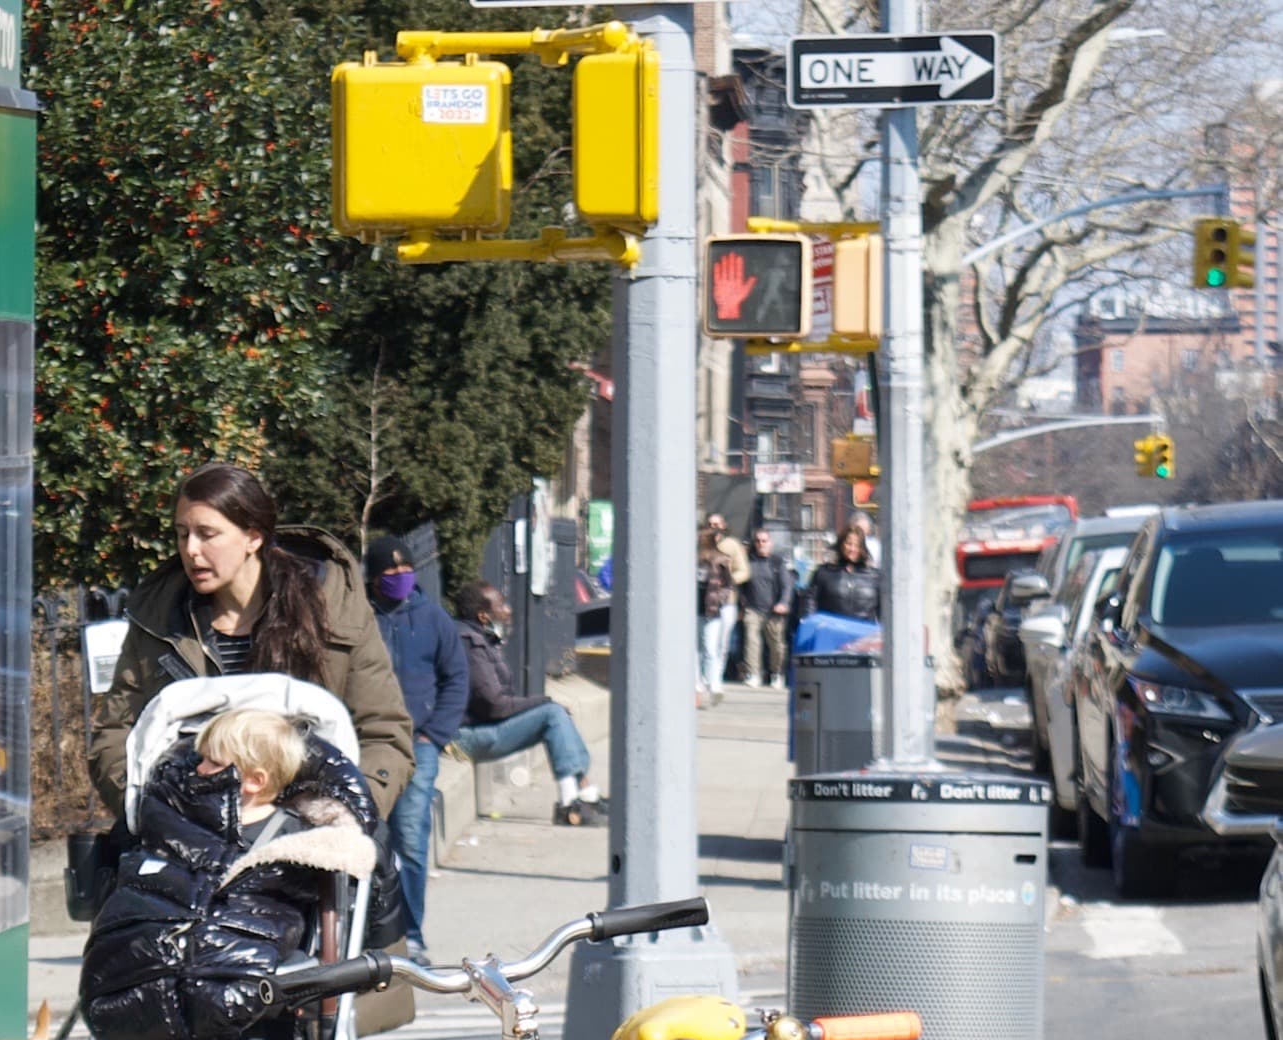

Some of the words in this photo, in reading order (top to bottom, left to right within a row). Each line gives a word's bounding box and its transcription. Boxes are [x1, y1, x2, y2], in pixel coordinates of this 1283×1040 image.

[809, 58, 874, 84] ONE
[912, 55, 971, 81] WAY
[461, 88, 483, 100] GO
[814, 783, 848, 797] Don't
[852, 783, 894, 798] litter
[940, 784, 984, 799] Don't
[987, 784, 1022, 799] litter
[820, 881, 849, 898] Put
[852, 881, 902, 900] litter
[909, 881, 929, 900] in
[937, 881, 963, 901] its
[968, 882, 1016, 904] place
